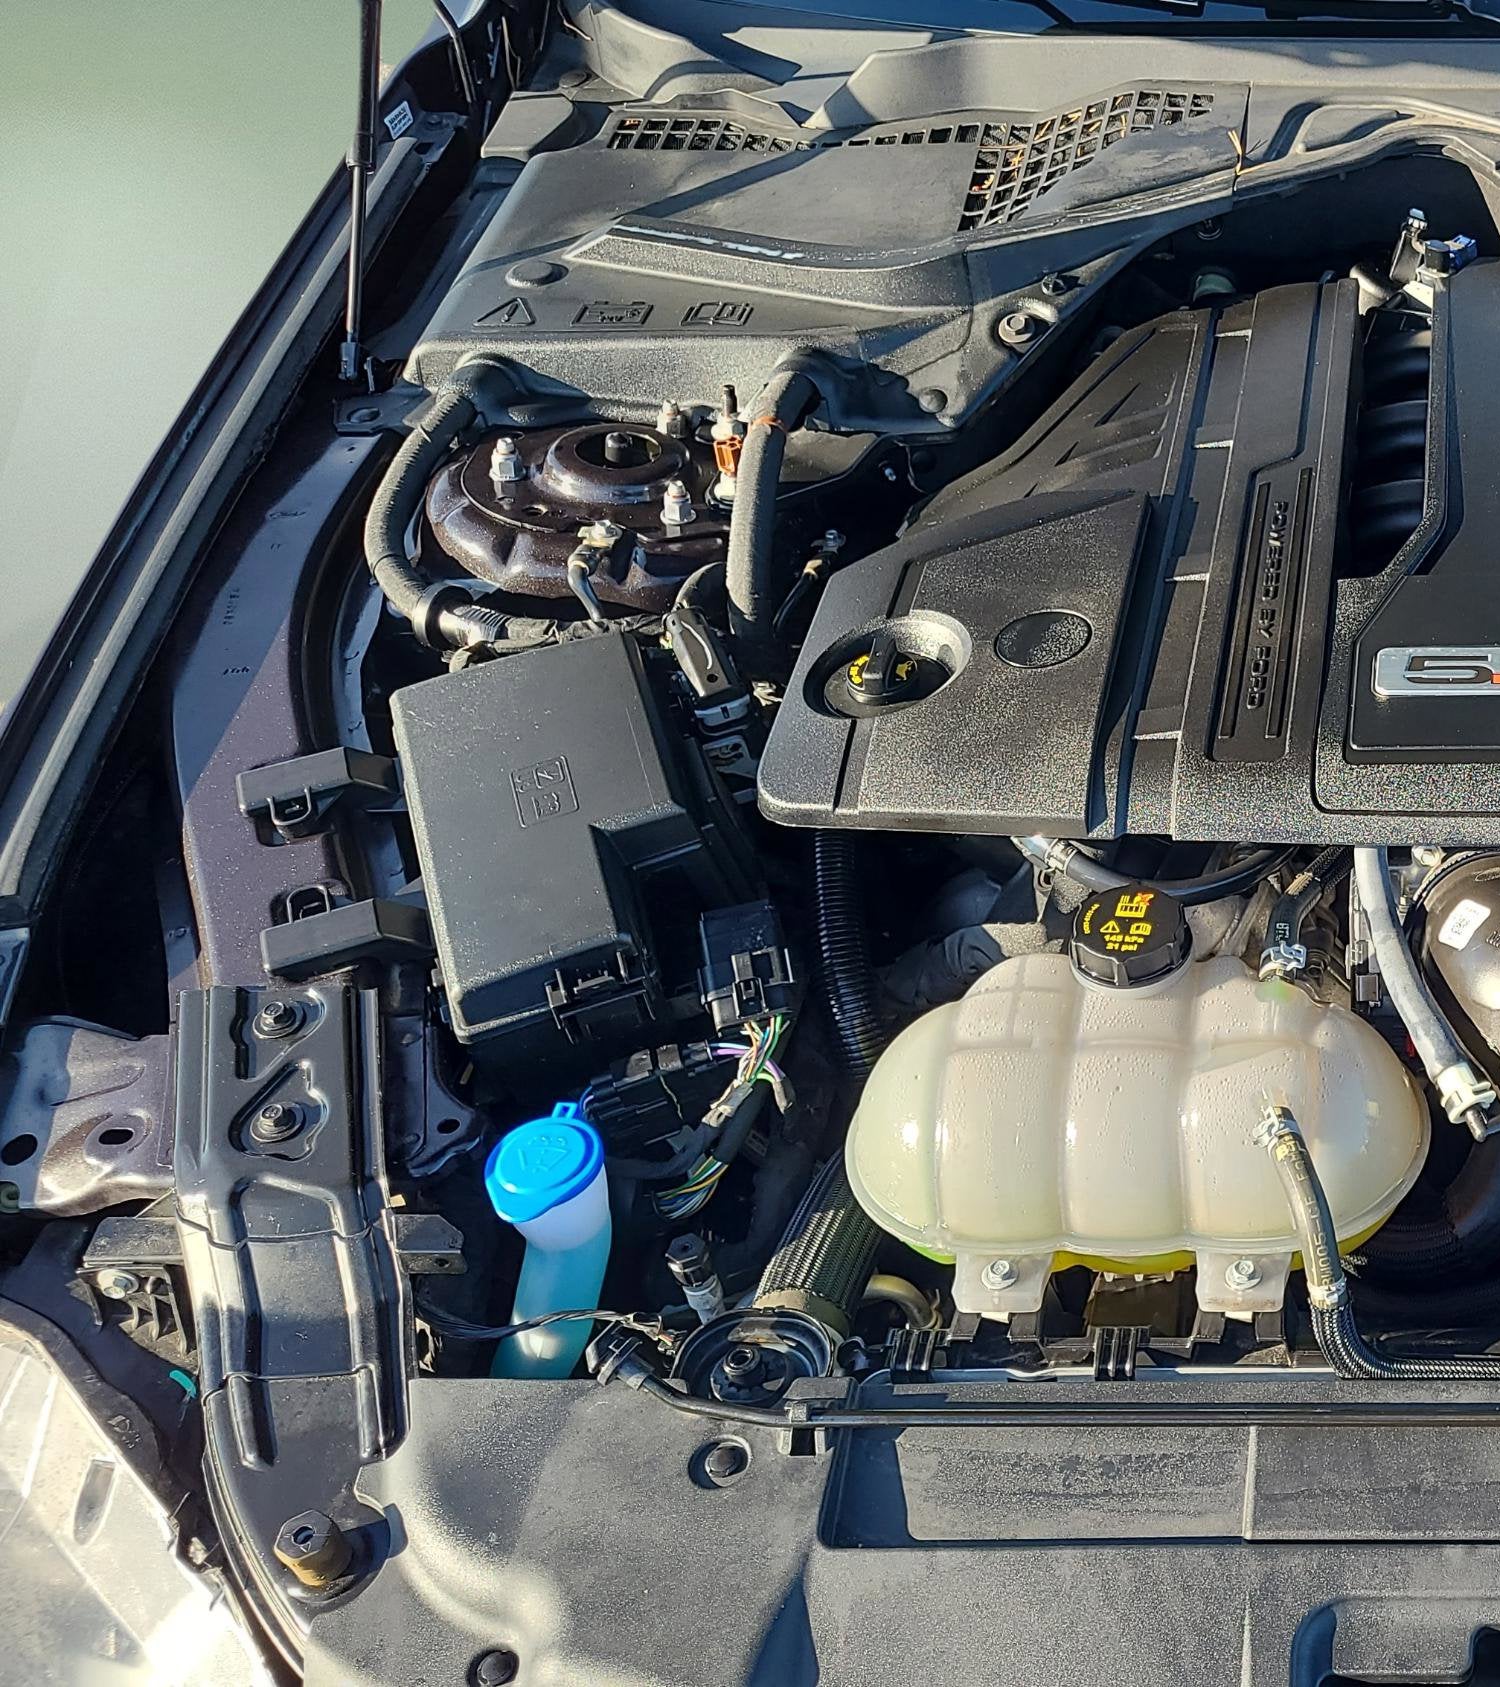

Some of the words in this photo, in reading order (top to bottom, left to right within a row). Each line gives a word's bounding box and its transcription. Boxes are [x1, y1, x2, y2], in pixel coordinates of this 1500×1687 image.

[1262, 501, 1289, 600] POWERED
[1258, 608, 1276, 639] BY
[1247, 646, 1271, 709] FORD
